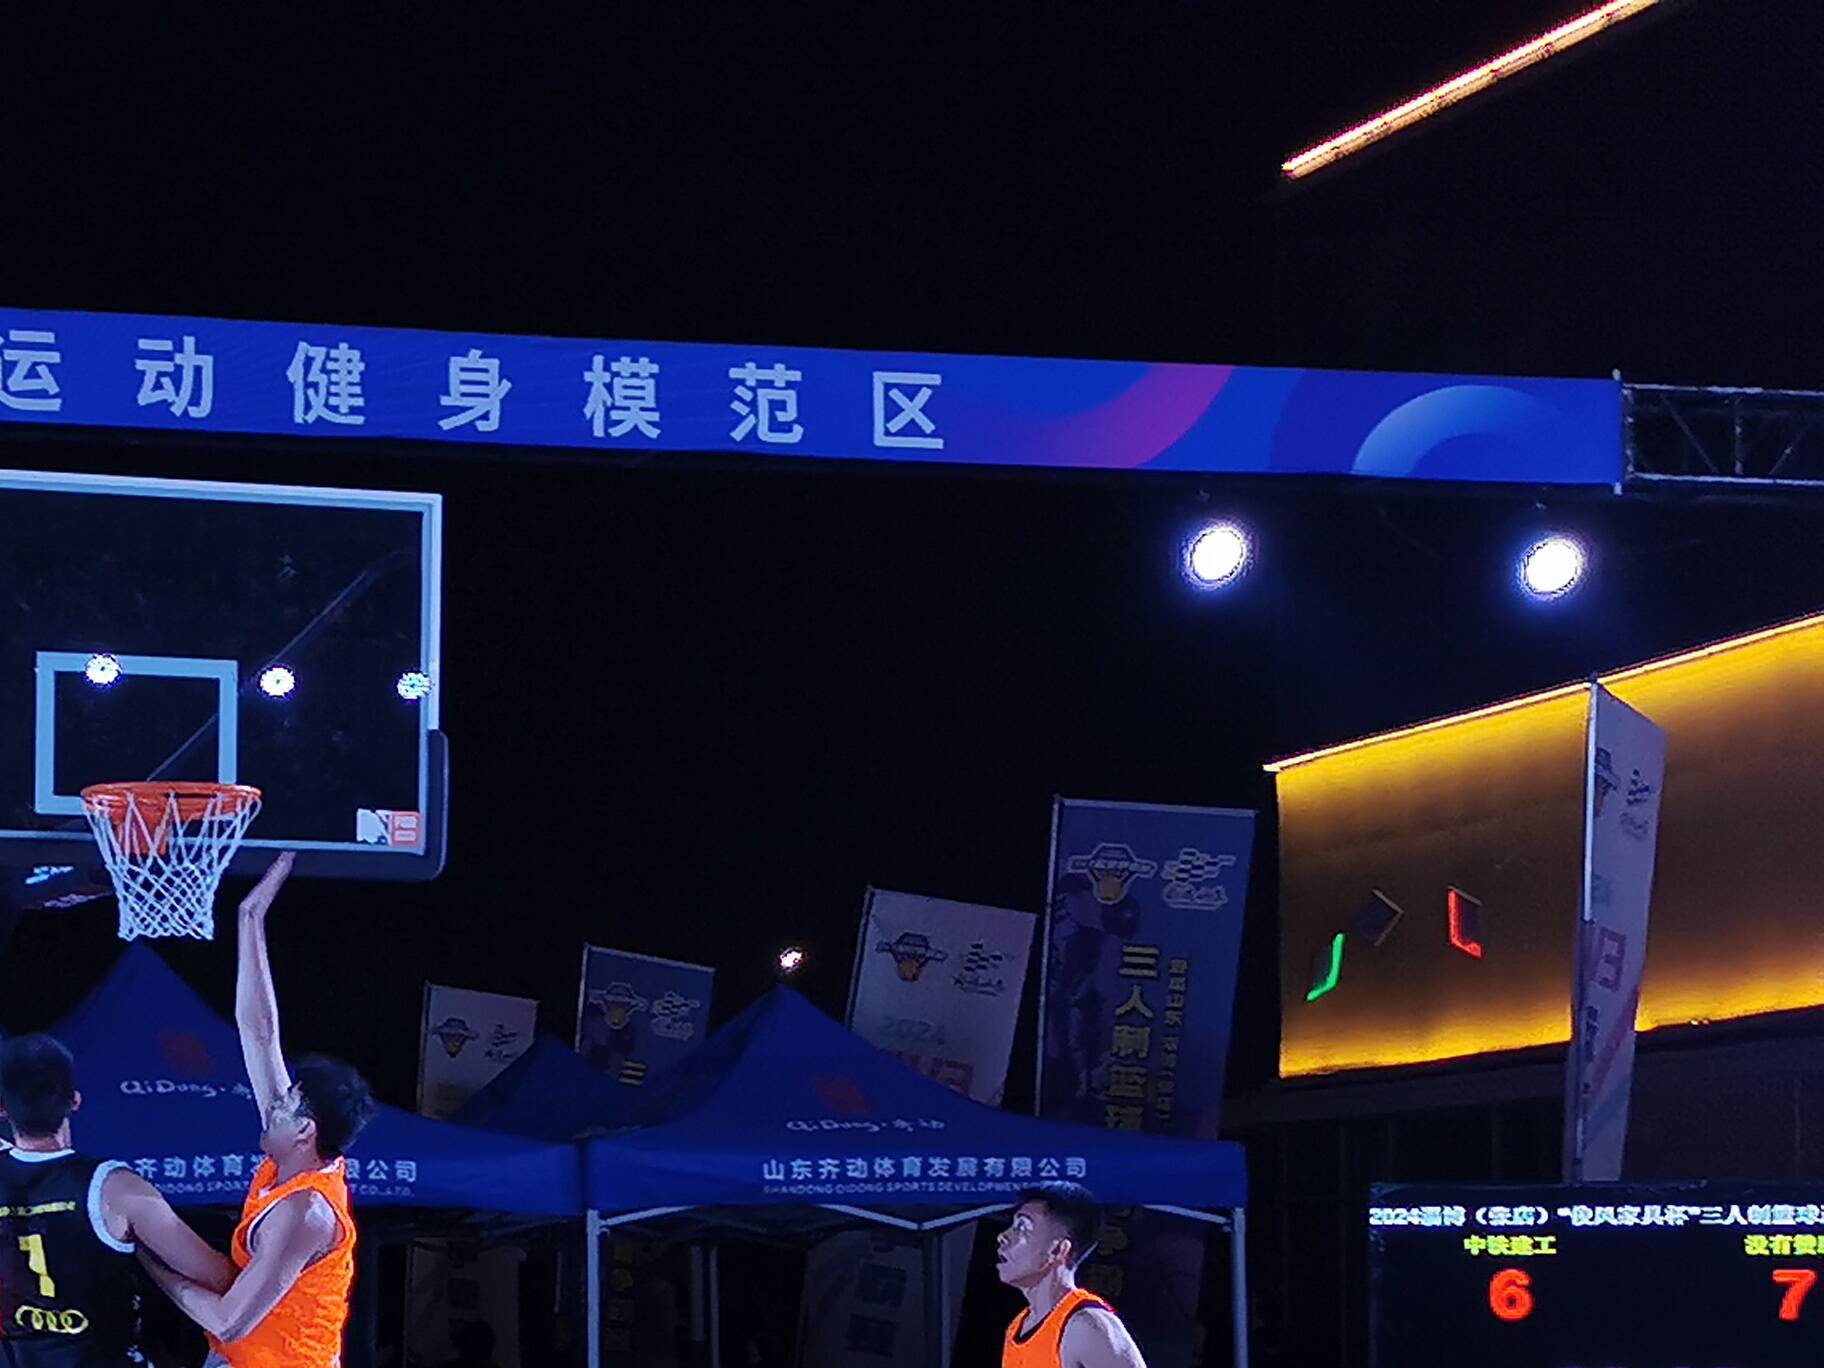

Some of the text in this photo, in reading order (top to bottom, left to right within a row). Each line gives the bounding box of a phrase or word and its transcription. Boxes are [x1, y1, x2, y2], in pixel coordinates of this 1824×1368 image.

[763, 1156, 1087, 1180] 山东齐动体育发展有限公司
[886, 1180, 936, 1193] SPORTS
[1488, 1268, 1535, 1322] 6
[1772, 1268, 1818, 1322] 7
